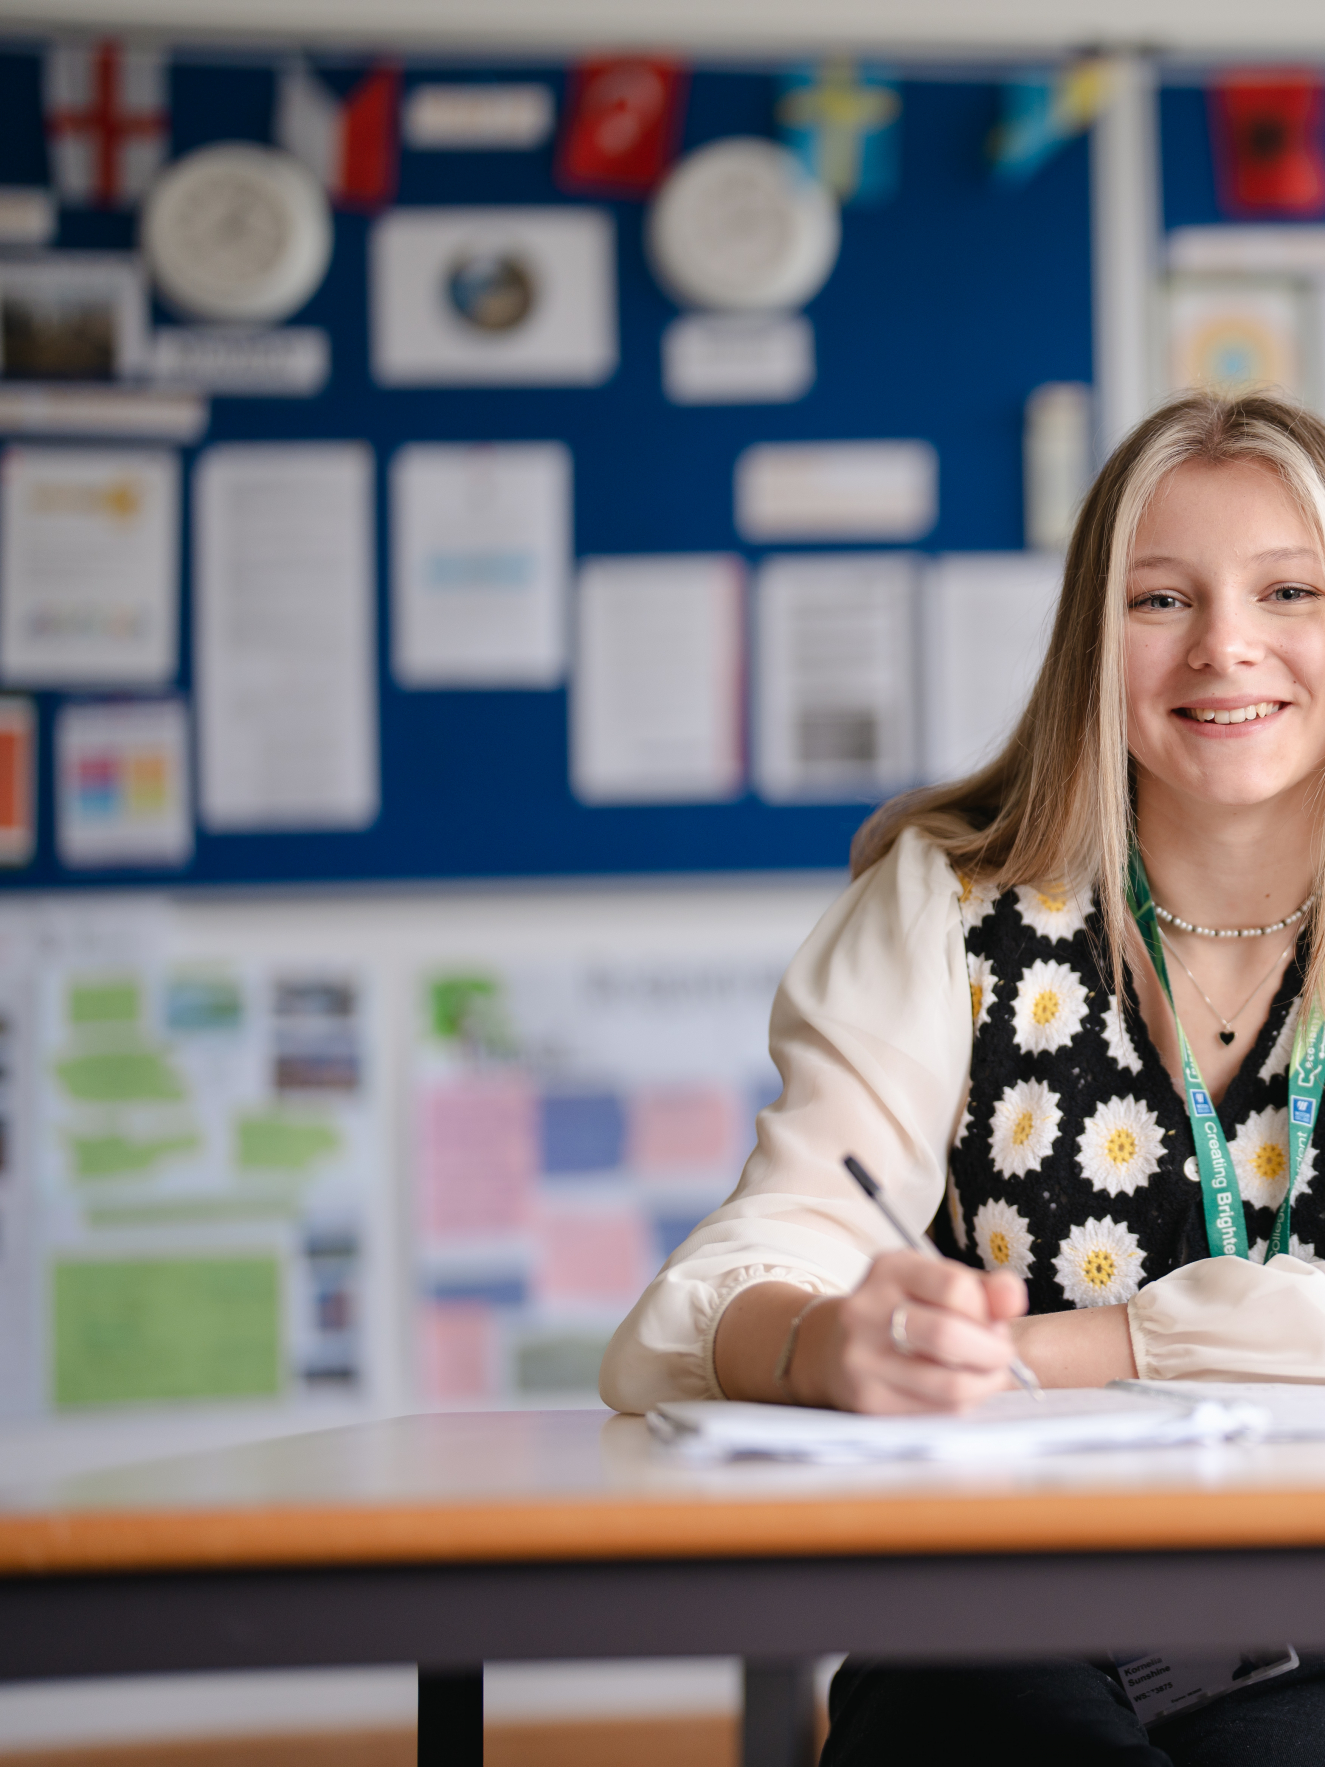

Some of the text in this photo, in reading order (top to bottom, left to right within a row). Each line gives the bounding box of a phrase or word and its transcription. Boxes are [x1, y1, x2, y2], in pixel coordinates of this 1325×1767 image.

[1204, 1121, 1238, 1256] Creating Brighte
[1123, 1657, 1163, 1677] Kornelia
[1127, 1665, 1171, 1687] Sunshine
